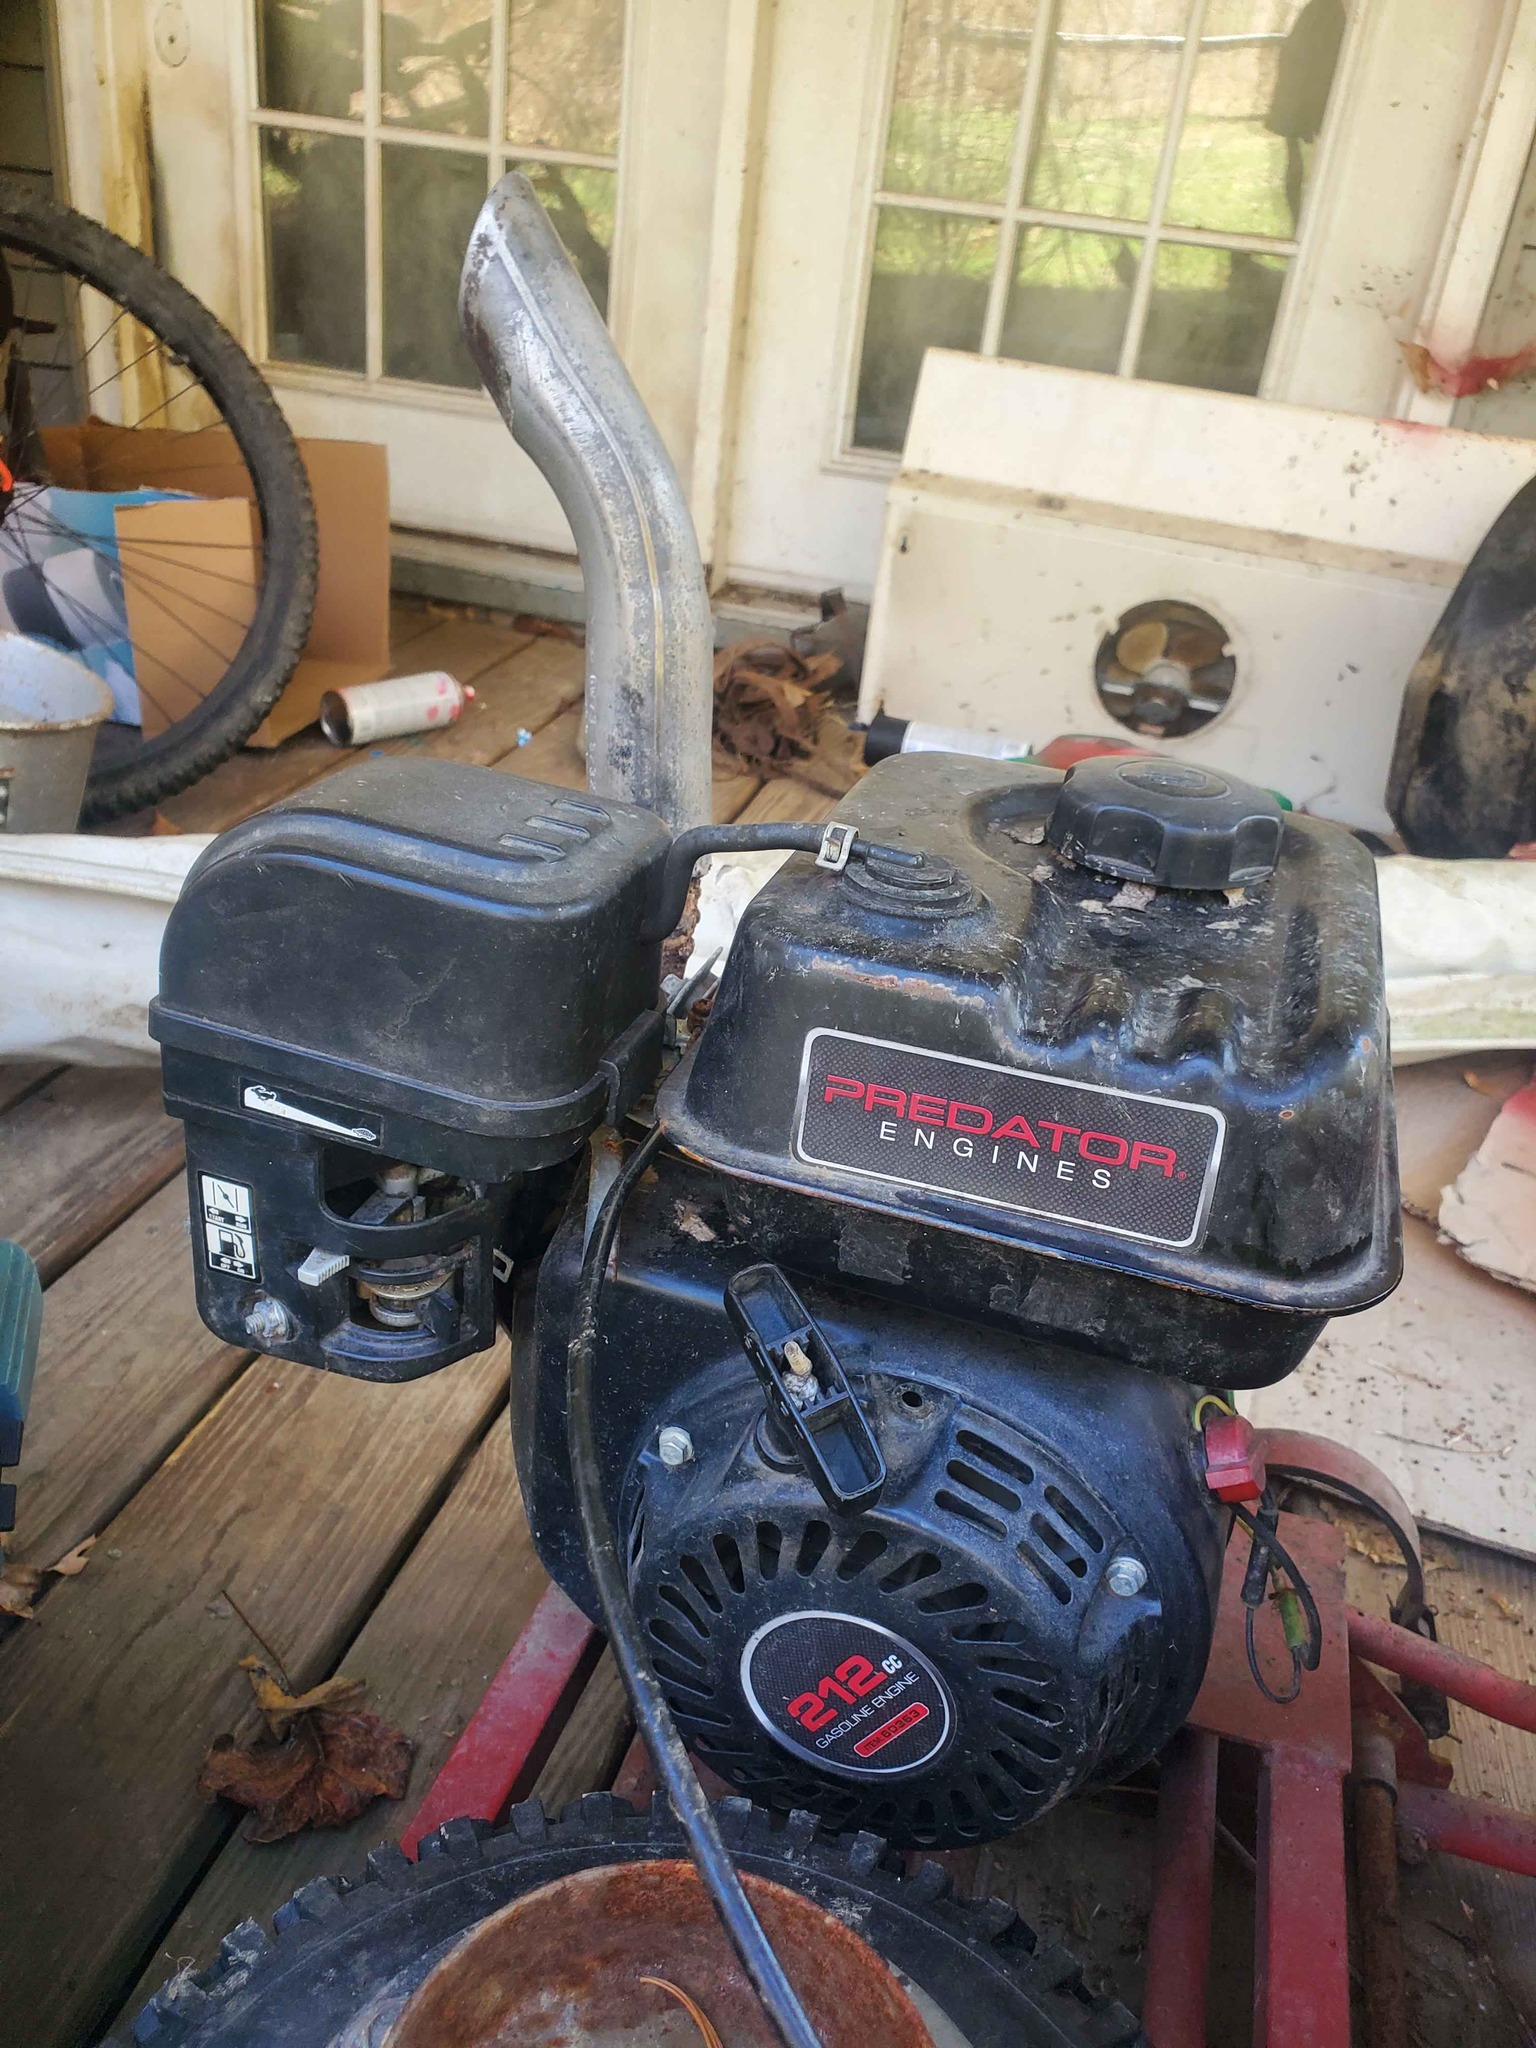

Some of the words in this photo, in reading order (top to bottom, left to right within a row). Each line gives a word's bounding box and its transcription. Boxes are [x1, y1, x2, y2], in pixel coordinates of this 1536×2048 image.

[879, 1120, 1111, 1189] ENGINES
[787, 1654, 888, 1732] 212
[815, 1704, 875, 1749] GASOLINE
[871, 1671, 920, 1708] ENGINE
